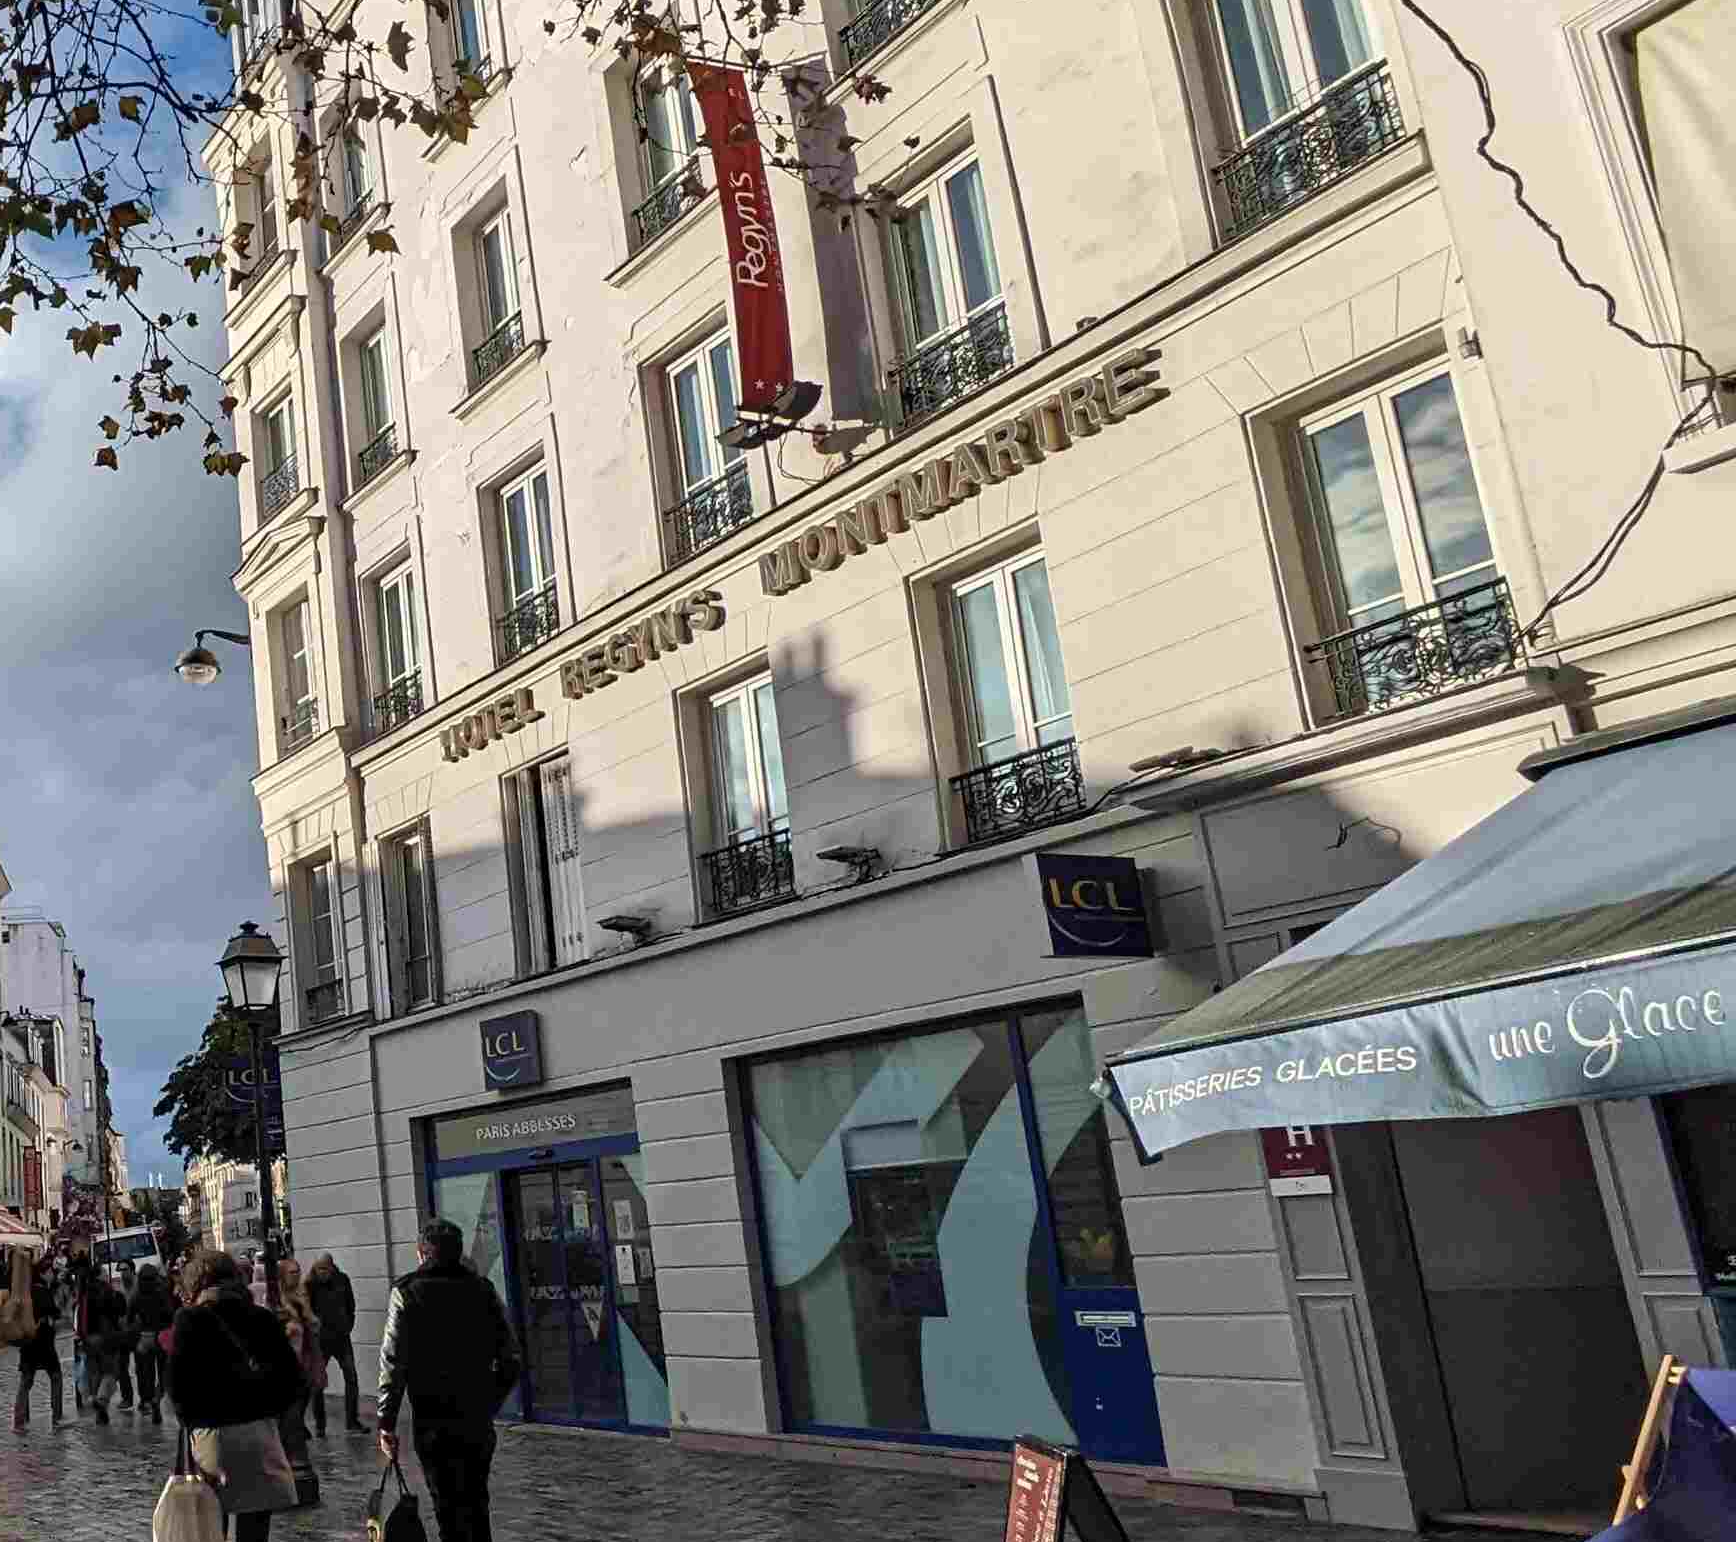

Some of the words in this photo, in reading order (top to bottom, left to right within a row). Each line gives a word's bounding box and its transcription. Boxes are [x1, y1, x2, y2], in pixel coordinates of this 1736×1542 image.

[439, 687, 546, 763] HOTEL
[758, 347, 1171, 596] MONTMARTRE
[1048, 877, 1136, 912] LCL
[485, 1030, 525, 1058] LCL
[1488, 1020, 1556, 1061] une
[1566, 985, 1726, 1079] Glace
[1128, 1065, 1264, 1117] PÂTISSERIES
[1275, 1044, 1418, 1084] GLACÉES
[475, 1123, 510, 1140] PARIS
